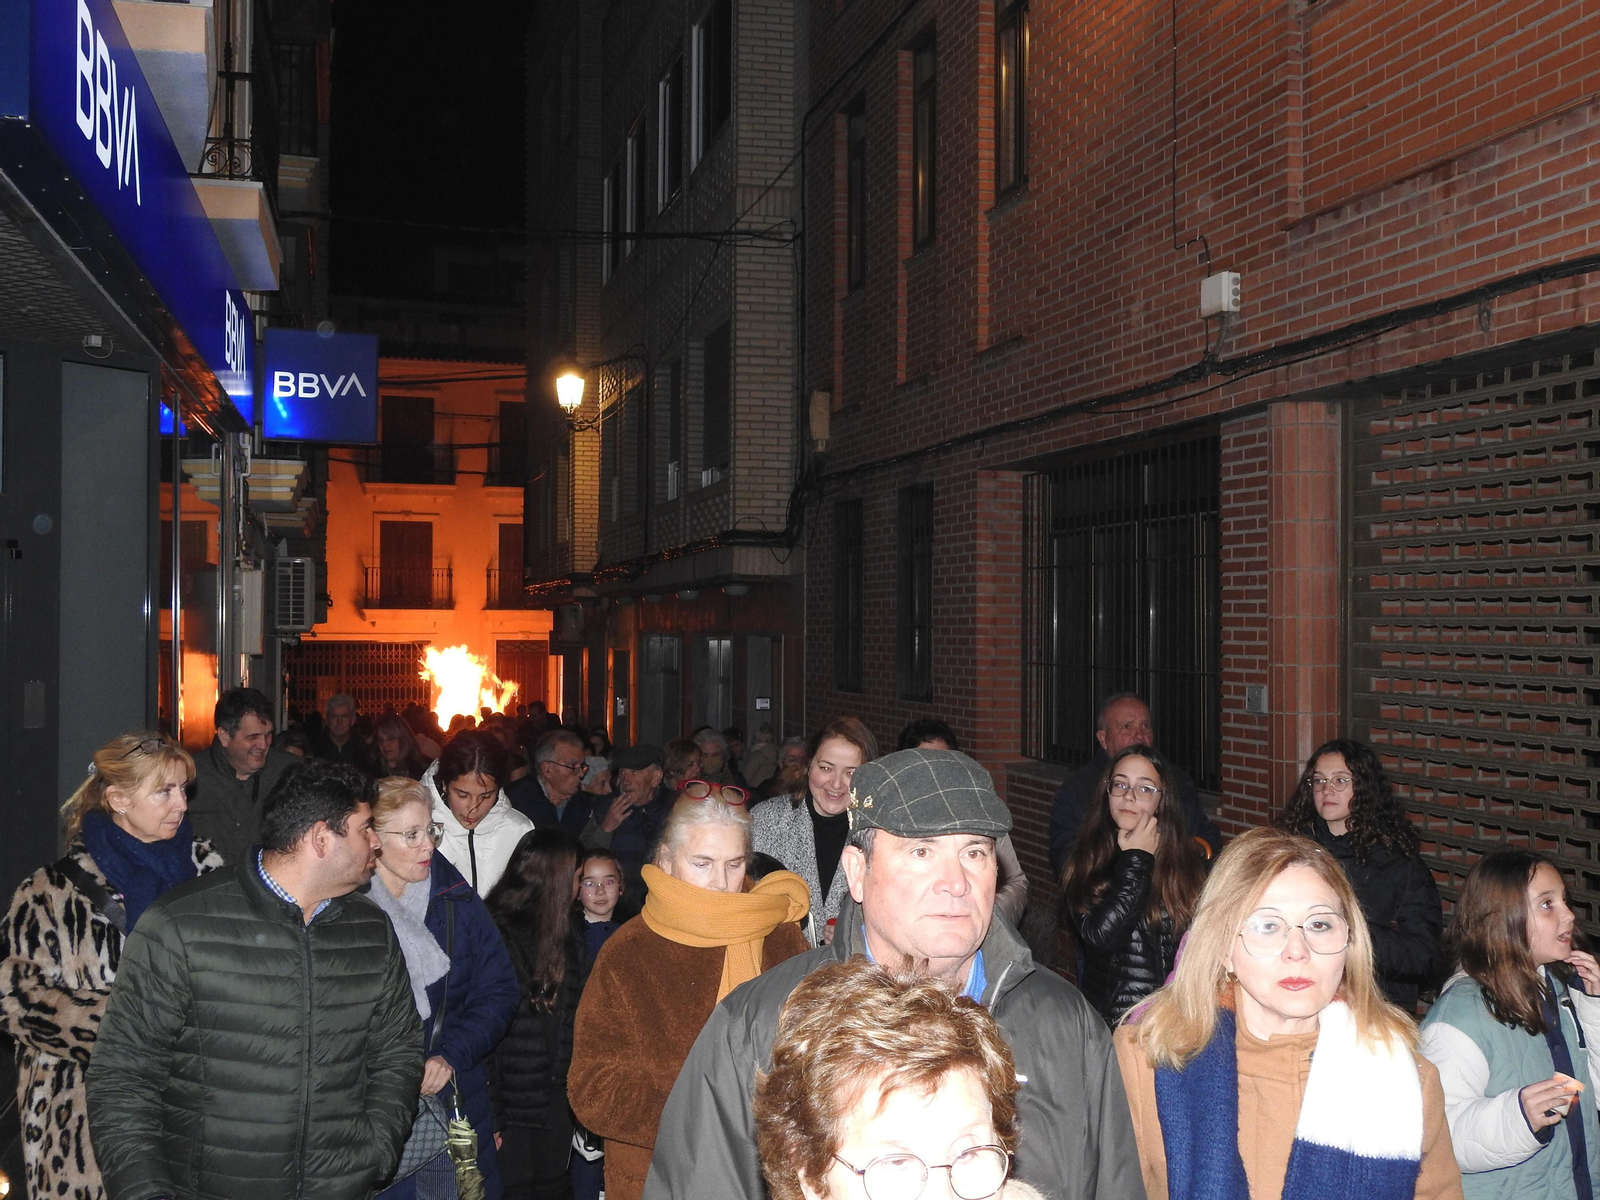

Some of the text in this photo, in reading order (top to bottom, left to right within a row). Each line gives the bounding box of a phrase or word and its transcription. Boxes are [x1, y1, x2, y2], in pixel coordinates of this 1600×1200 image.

[76, 0, 141, 206] BBVA
[225, 289, 246, 381] BBVA
[273, 371, 366, 399] BBVA
